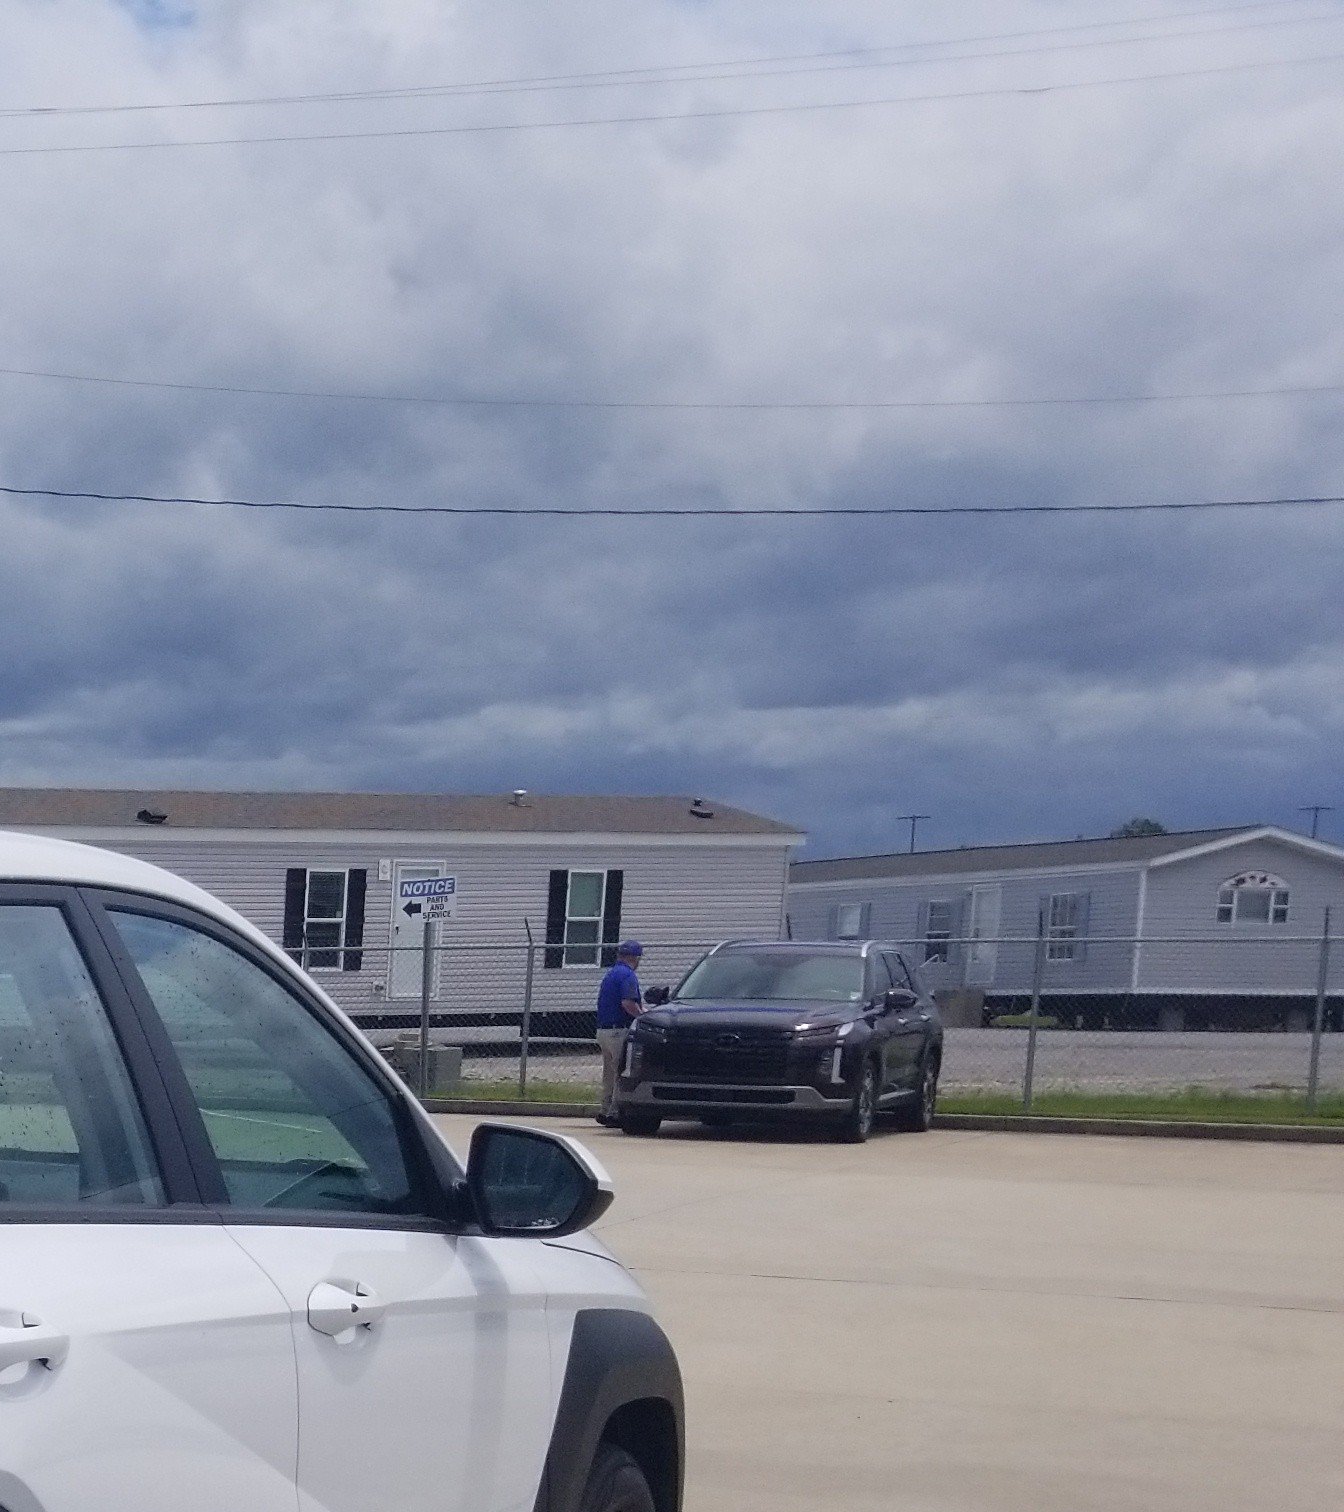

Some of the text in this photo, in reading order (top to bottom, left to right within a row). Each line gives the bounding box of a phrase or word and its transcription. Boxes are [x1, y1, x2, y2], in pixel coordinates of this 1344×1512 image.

[402, 880, 454, 896] NOTICE
[426, 896, 448, 904] PARTS
[423, 910, 451, 920] SERVICE
